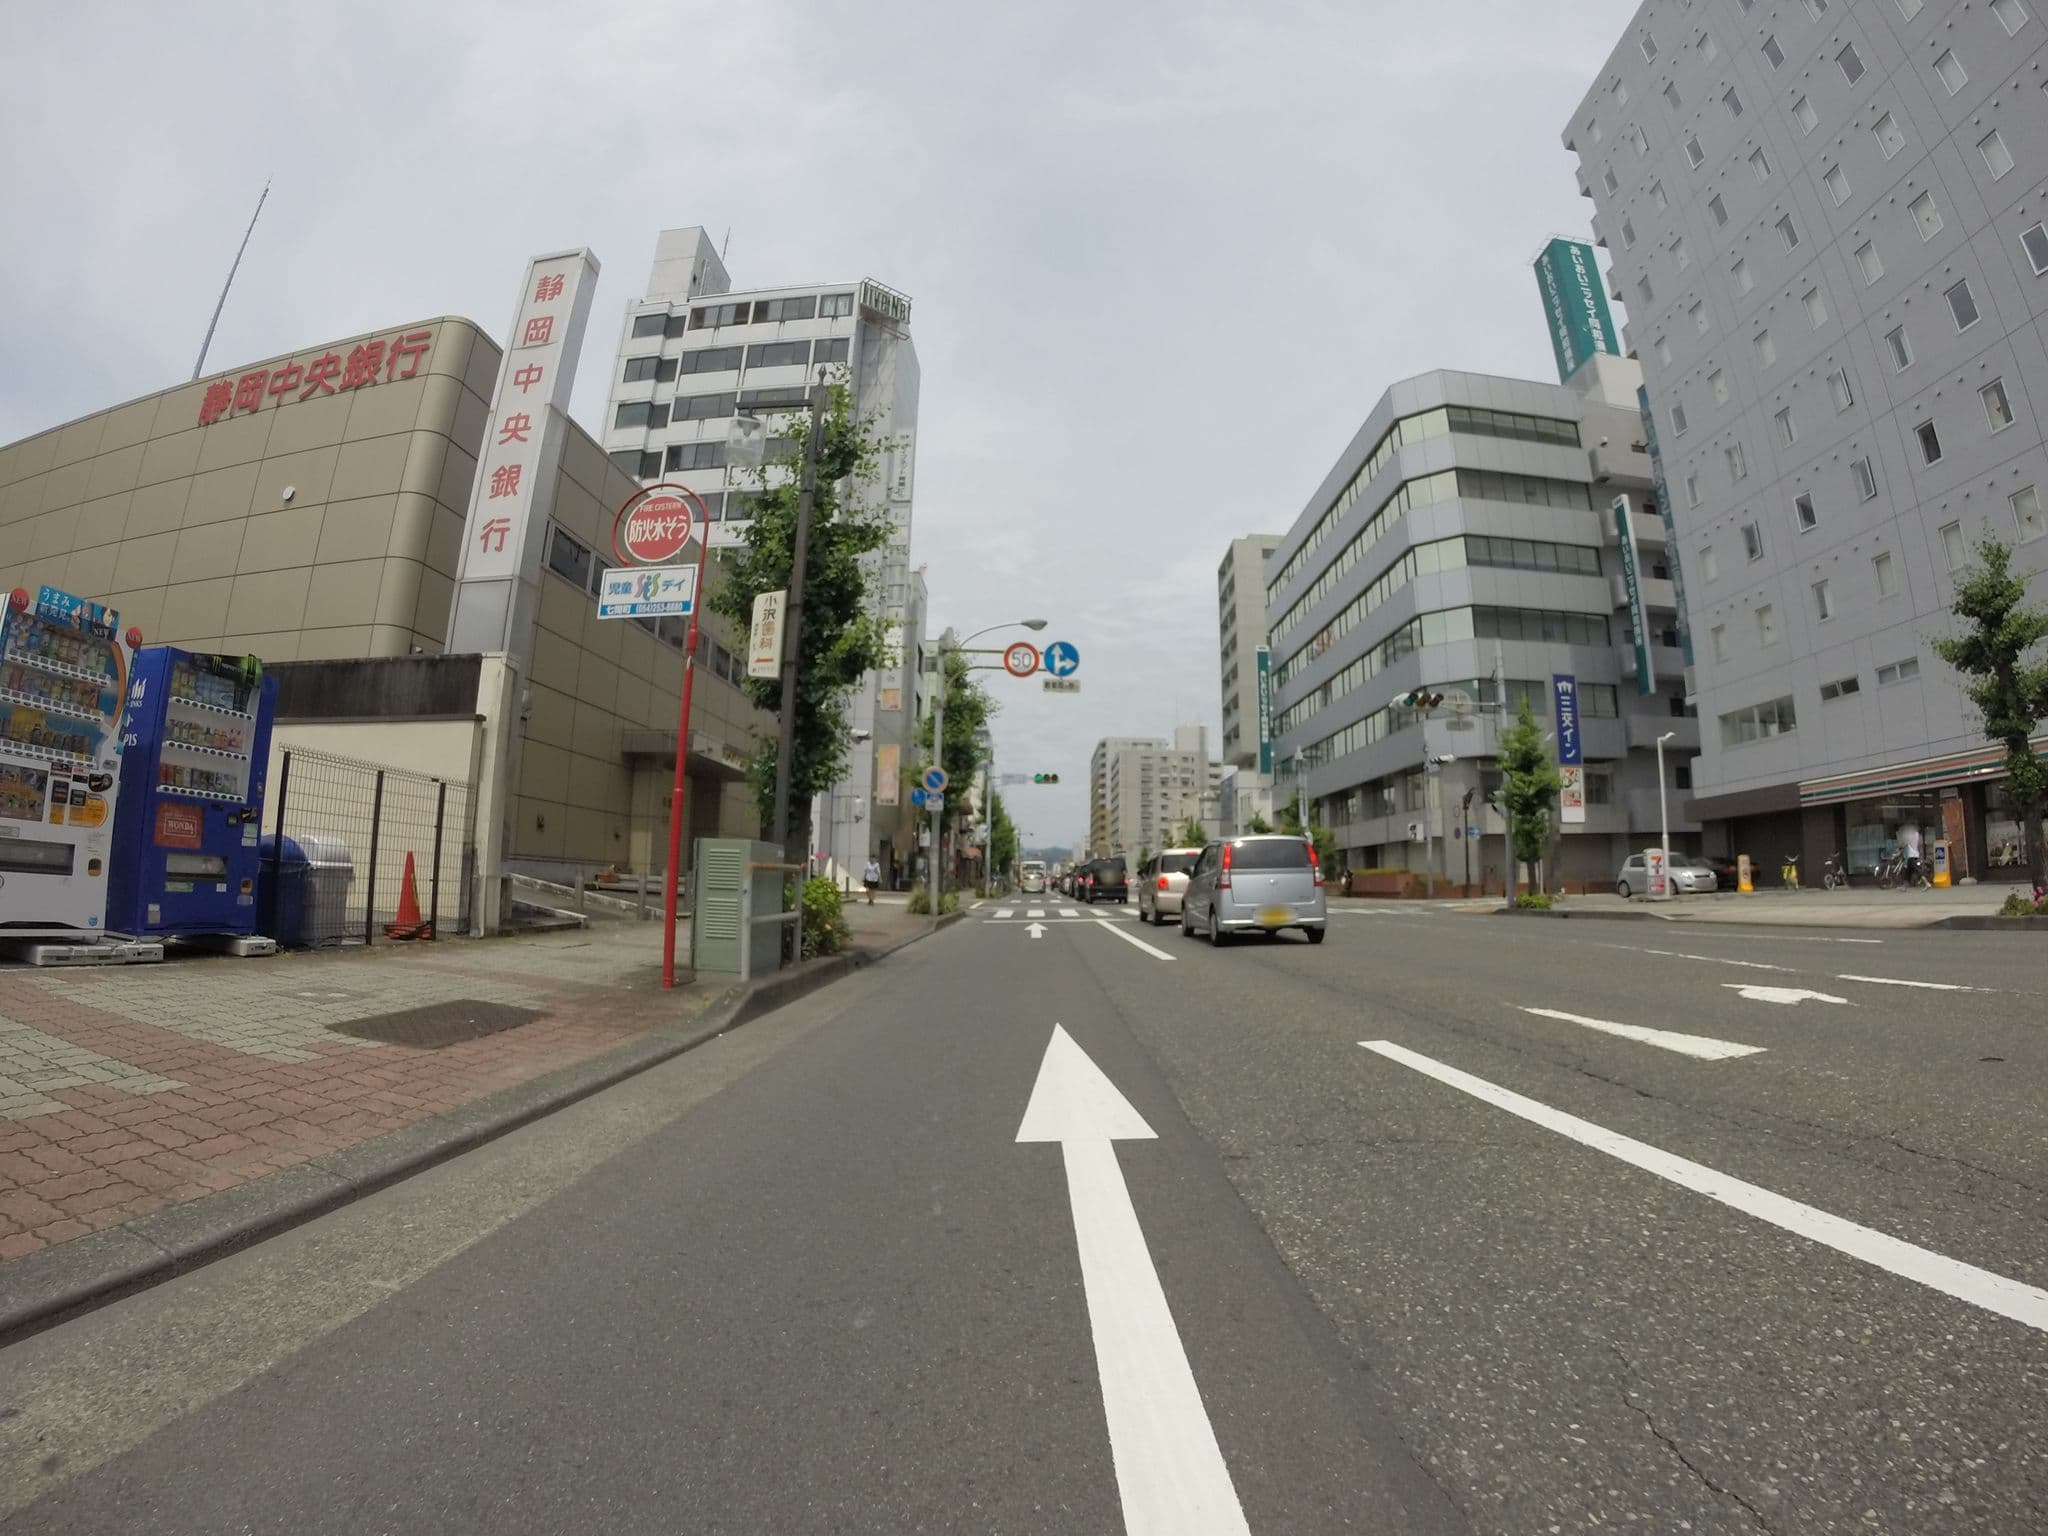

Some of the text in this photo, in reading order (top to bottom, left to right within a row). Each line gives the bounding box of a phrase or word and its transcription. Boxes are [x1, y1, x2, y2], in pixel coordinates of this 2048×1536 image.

[198, 331, 431, 426] 静岡中央銀行
[480, 273, 565, 554] 静岡中央銀行
[640, 502, 682, 512] FIRE CISTERN
[629, 515, 688, 543] 防火水そう
[662, 579, 685, 592] デイ
[43, 588, 70, 607] うまみ
[760, 595, 777, 649] 小沢歯科
[1012, 652, 1032, 668] 50
[123, 733, 138, 747] PIS
[168, 820, 194, 832] WONDA
